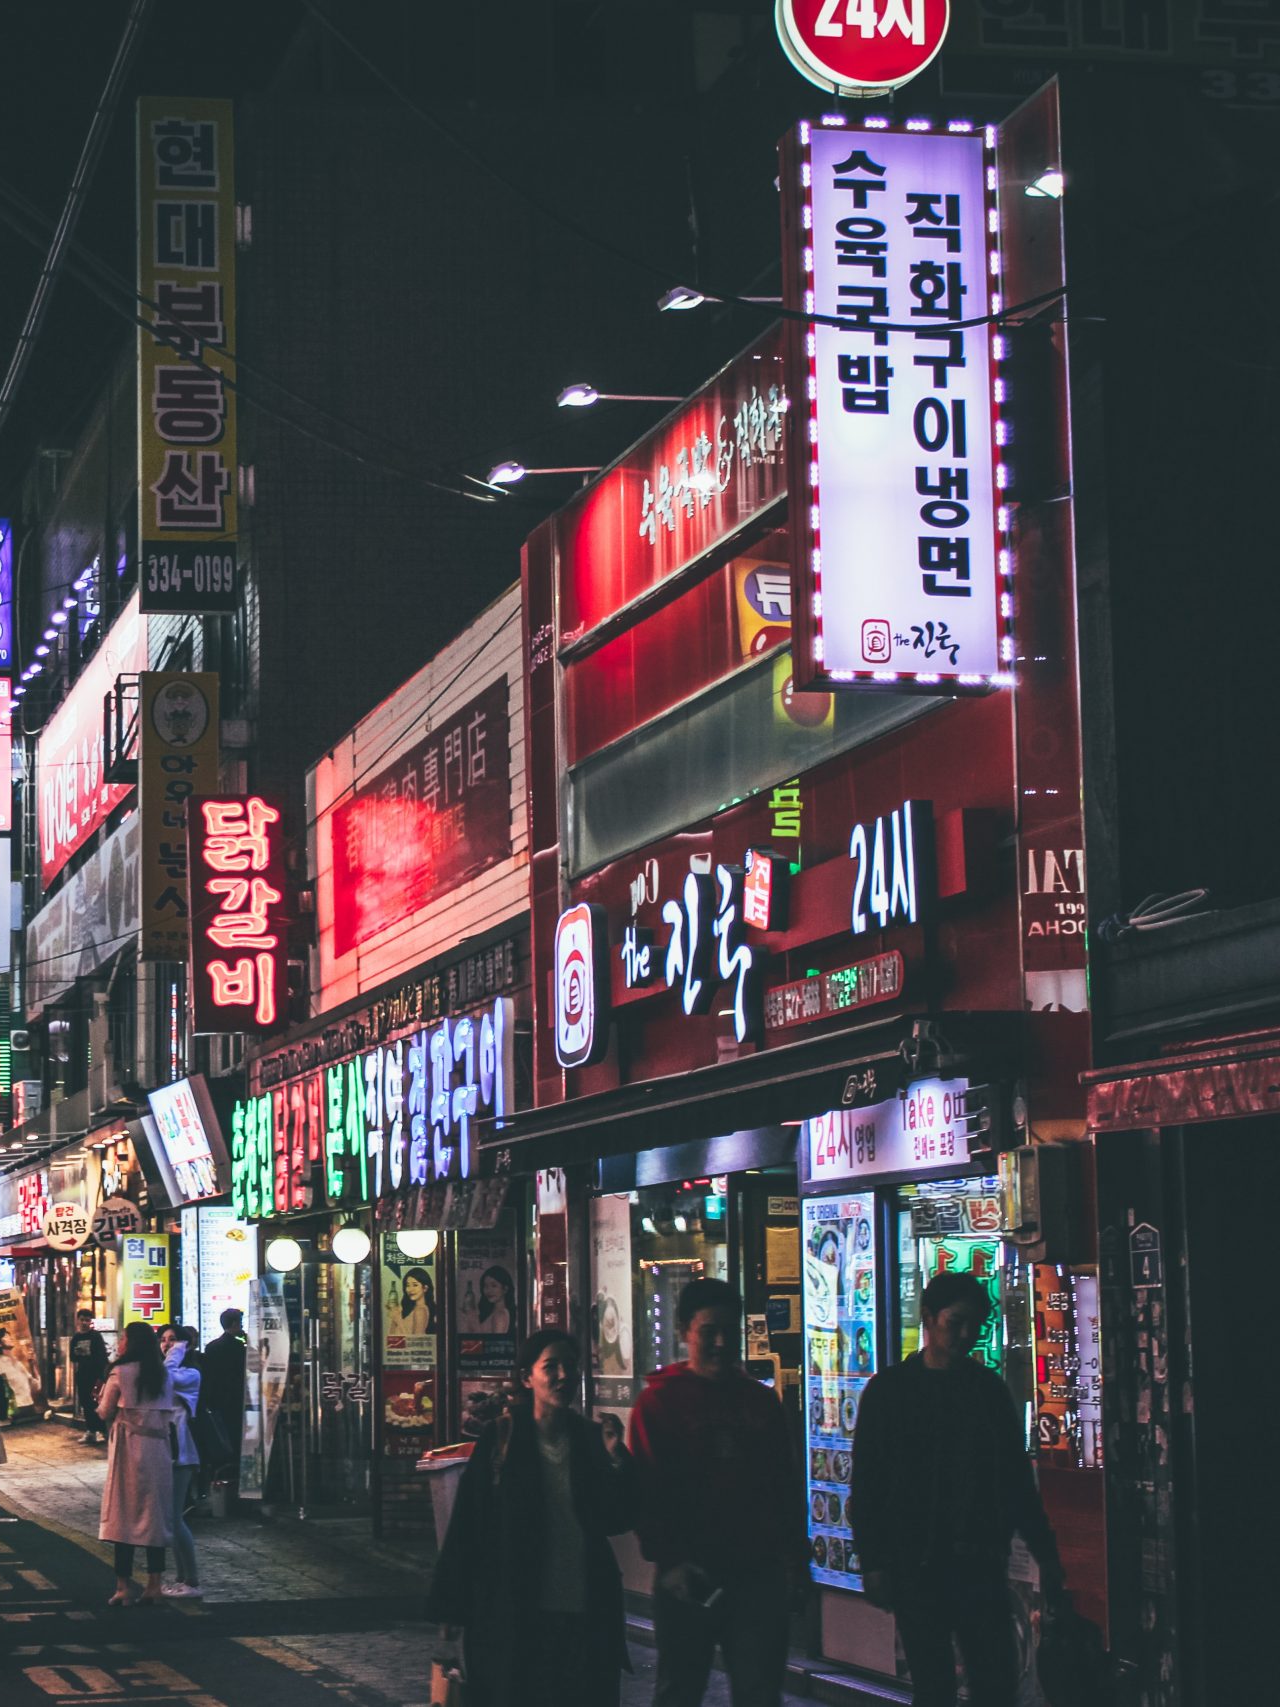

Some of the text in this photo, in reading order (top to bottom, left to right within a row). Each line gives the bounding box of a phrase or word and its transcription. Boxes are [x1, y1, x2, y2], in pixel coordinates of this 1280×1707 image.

[832, 151, 894, 415] 수육국밥
[904, 193, 972, 597] 직화구이냉면
[147, 555, 233, 593] 334-0199
[911, 621, 960, 665] 진국
[201, 796, 281, 1026] 닭갈비
[849, 800, 917, 935] 24시
[621, 927, 650, 988] the
[47, 1219, 87, 1236] 사격장
